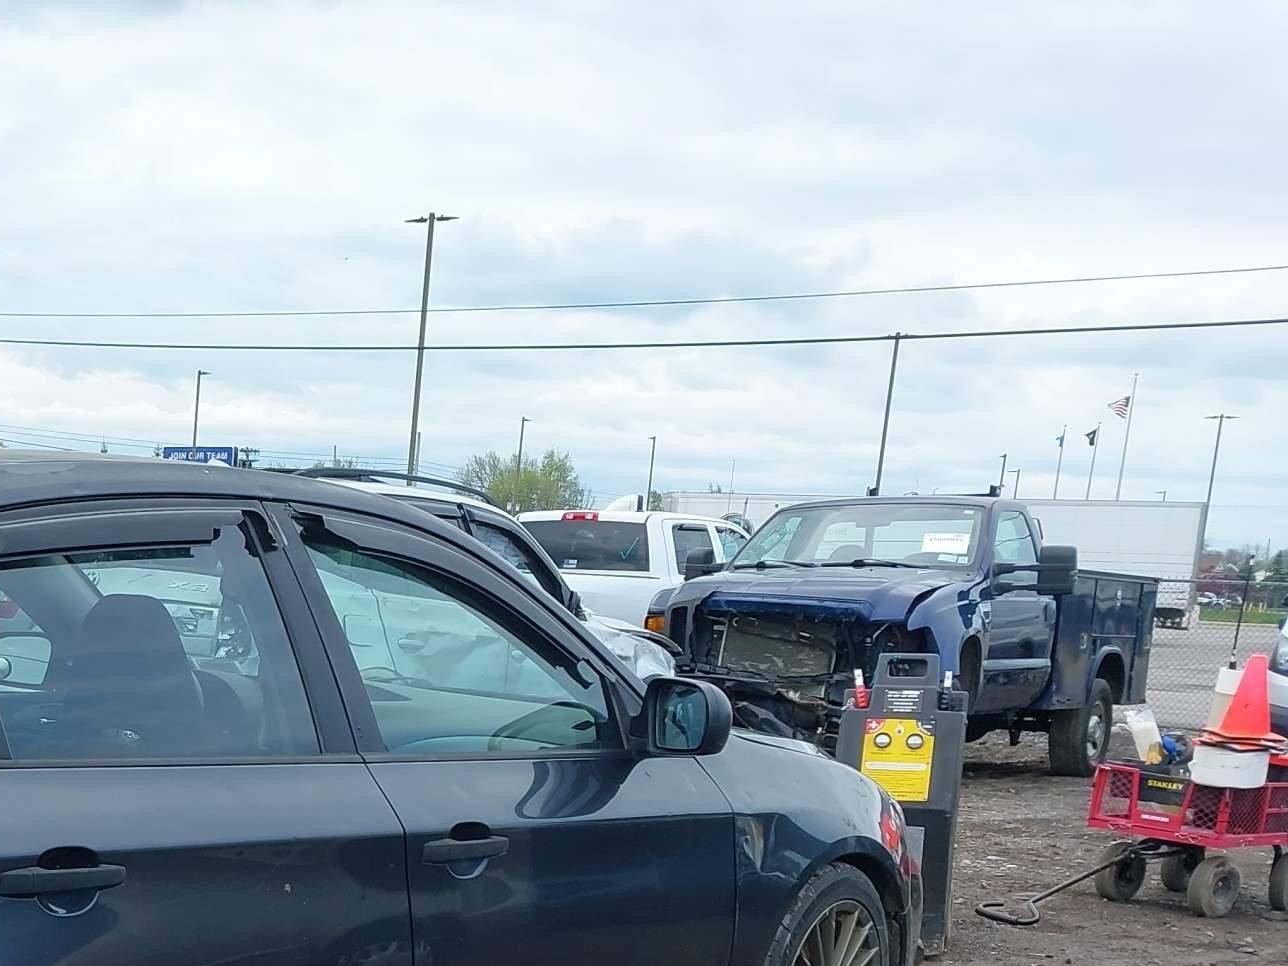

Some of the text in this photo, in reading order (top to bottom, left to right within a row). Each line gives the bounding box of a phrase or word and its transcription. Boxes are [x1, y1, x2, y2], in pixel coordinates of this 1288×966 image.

[169, 451, 187, 461] JOIN
[207, 451, 228, 460] TEAM
[1147, 779, 1184, 790] STANLEY
